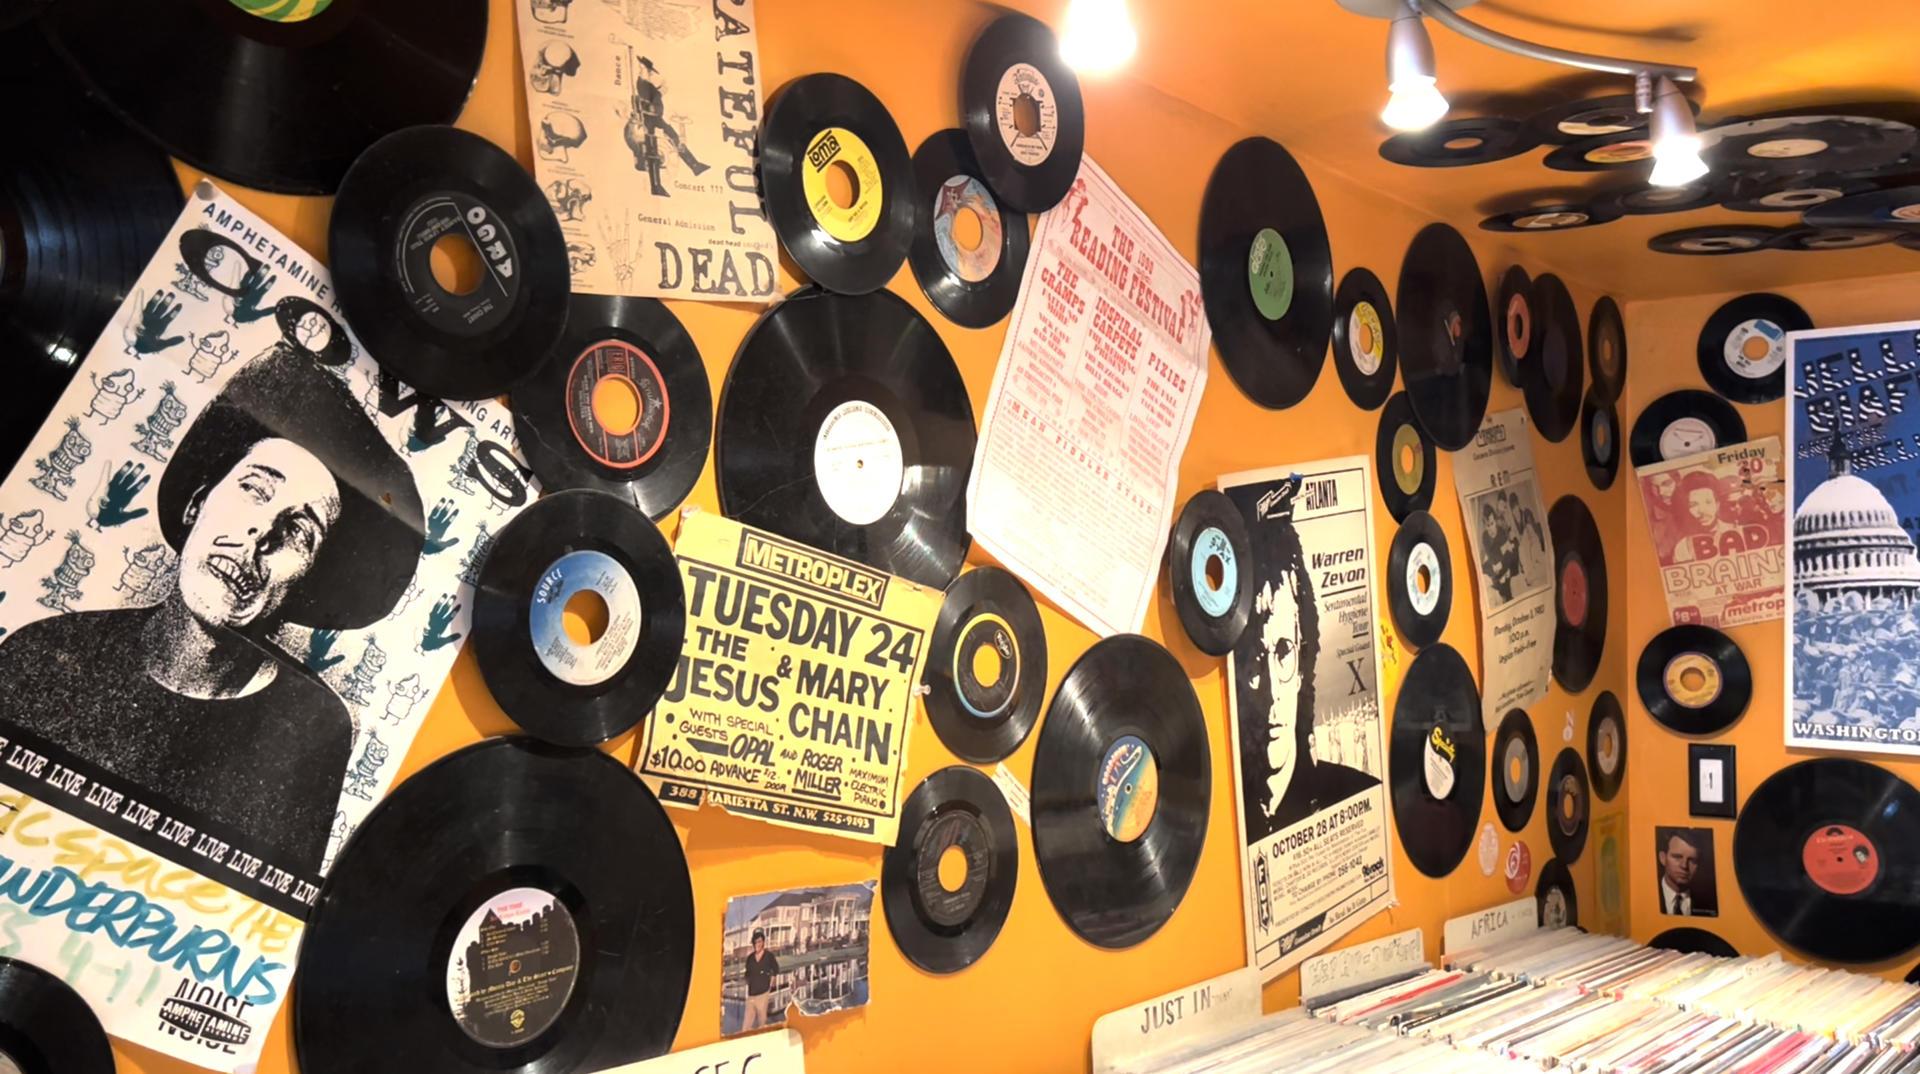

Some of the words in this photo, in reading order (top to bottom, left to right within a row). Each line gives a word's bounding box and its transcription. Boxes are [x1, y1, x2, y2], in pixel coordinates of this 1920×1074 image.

[203, 201, 330, 298] AMPHETAMINE
[466, 206, 514, 279] ARGO
[1111, 224, 1135, 265] THE
[654, 241, 775, 297] DEAD
[1040, 267, 1086, 315] CRAMPS
[1057, 260, 1080, 290] THE
[1069, 217, 1129, 291] READING
[1128, 273, 1185, 345] FESTIVAL
[1092, 313, 1138, 361] CARPETS
[1095, 296, 1143, 348] INSPIRAL
[1147, 351, 1187, 393] PIXIES
[1794, 331, 1920, 400] JELL
[1716, 446, 1767, 465] Friday
[1311, 547, 1365, 571] Warren
[1691, 523, 1771, 562] BAD
[744, 538, 882, 605] METROPLEX
[1321, 566, 1367, 589] Zevon
[1714, 583, 1729, 596] AT
[1734, 577, 1764, 593] WAR
[687, 566, 862, 657] TUESDAY
[863, 623, 915, 675] 24
[696, 625, 750, 662] THE
[663, 654, 780, 713] JESUS
[776, 654, 793, 679] &
[795, 659, 890, 712] MARY
[1346, 656, 1368, 698] X
[690, 708, 722, 726] WITH
[726, 715, 775, 736] SPECIAL
[788, 702, 893, 766] CHAIN
[1794, 721, 1920, 742] WASHINGTO
[679, 720, 729, 742] GUESTS
[729, 733, 776, 767] OPAL
[801, 748, 844, 774] ROGER
[669, 785, 699, 800] 388
[709, 760, 762, 784] ADVANCE
[793, 767, 842, 795] MILLER
[849, 767, 889, 788] MAXIMUM
[850, 779, 887, 799] ELECTRIC
[7, 745, 47, 778] LIVE
[46, 764, 82, 797] LIVE
[85, 781, 121, 815] LIVE
[122, 799, 157, 831] LIVE
[159, 817, 193, 849] LIVE
[194, 833, 229, 863] LIVE
[226, 848, 259, 880] LIVE
[259, 864, 291, 894] LIVE
[1271, 825, 1315, 859] OCTOBER
[1316, 818, 1328, 838] 28
[1328, 812, 1339, 830] AT
[1257, 863, 1270, 922] FOX
[1471, 910, 1510, 940] AFRICA
[1140, 995, 1185, 1034] JUST
[1193, 985, 1211, 1015] IN
